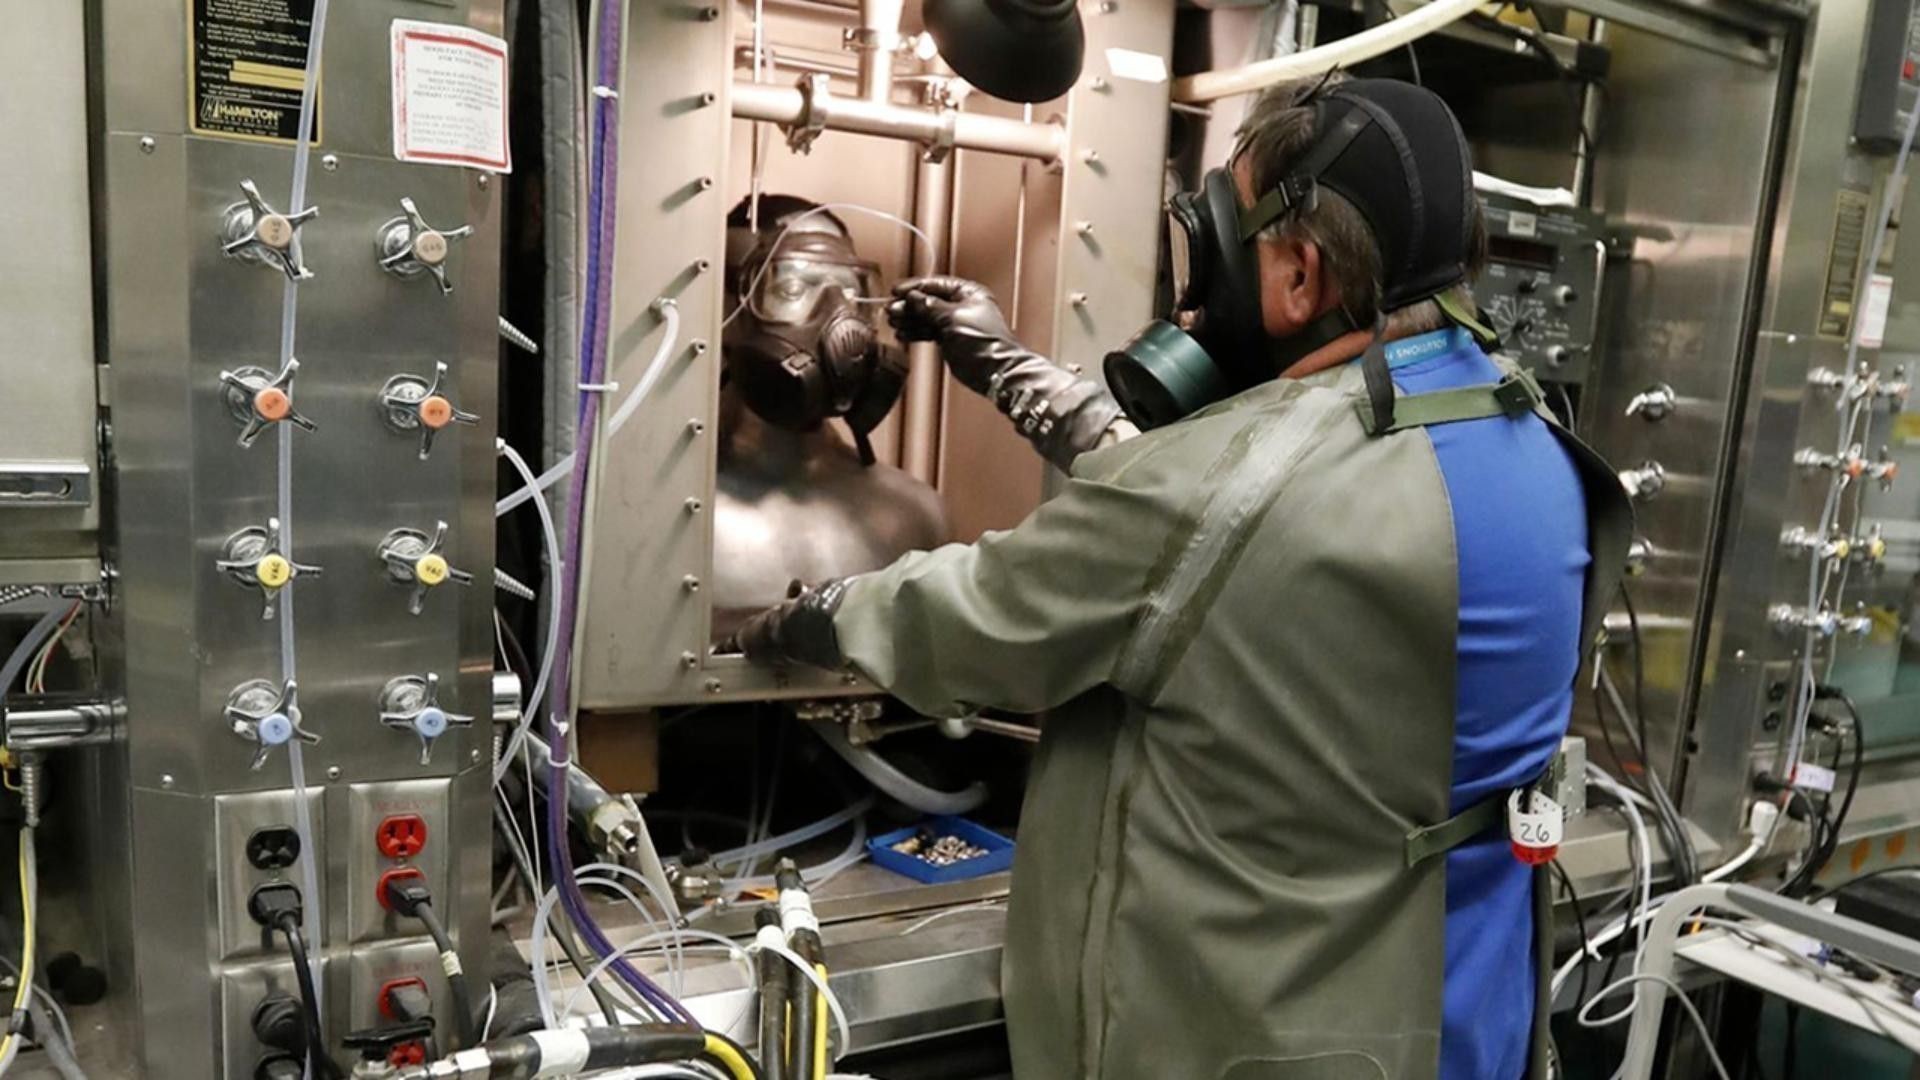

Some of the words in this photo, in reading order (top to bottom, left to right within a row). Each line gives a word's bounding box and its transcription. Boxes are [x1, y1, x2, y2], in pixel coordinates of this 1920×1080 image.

[219, 103, 279, 120] HAMILTON
[425, 565, 443, 577] VAC
[1519, 822, 1550, 843] 26
